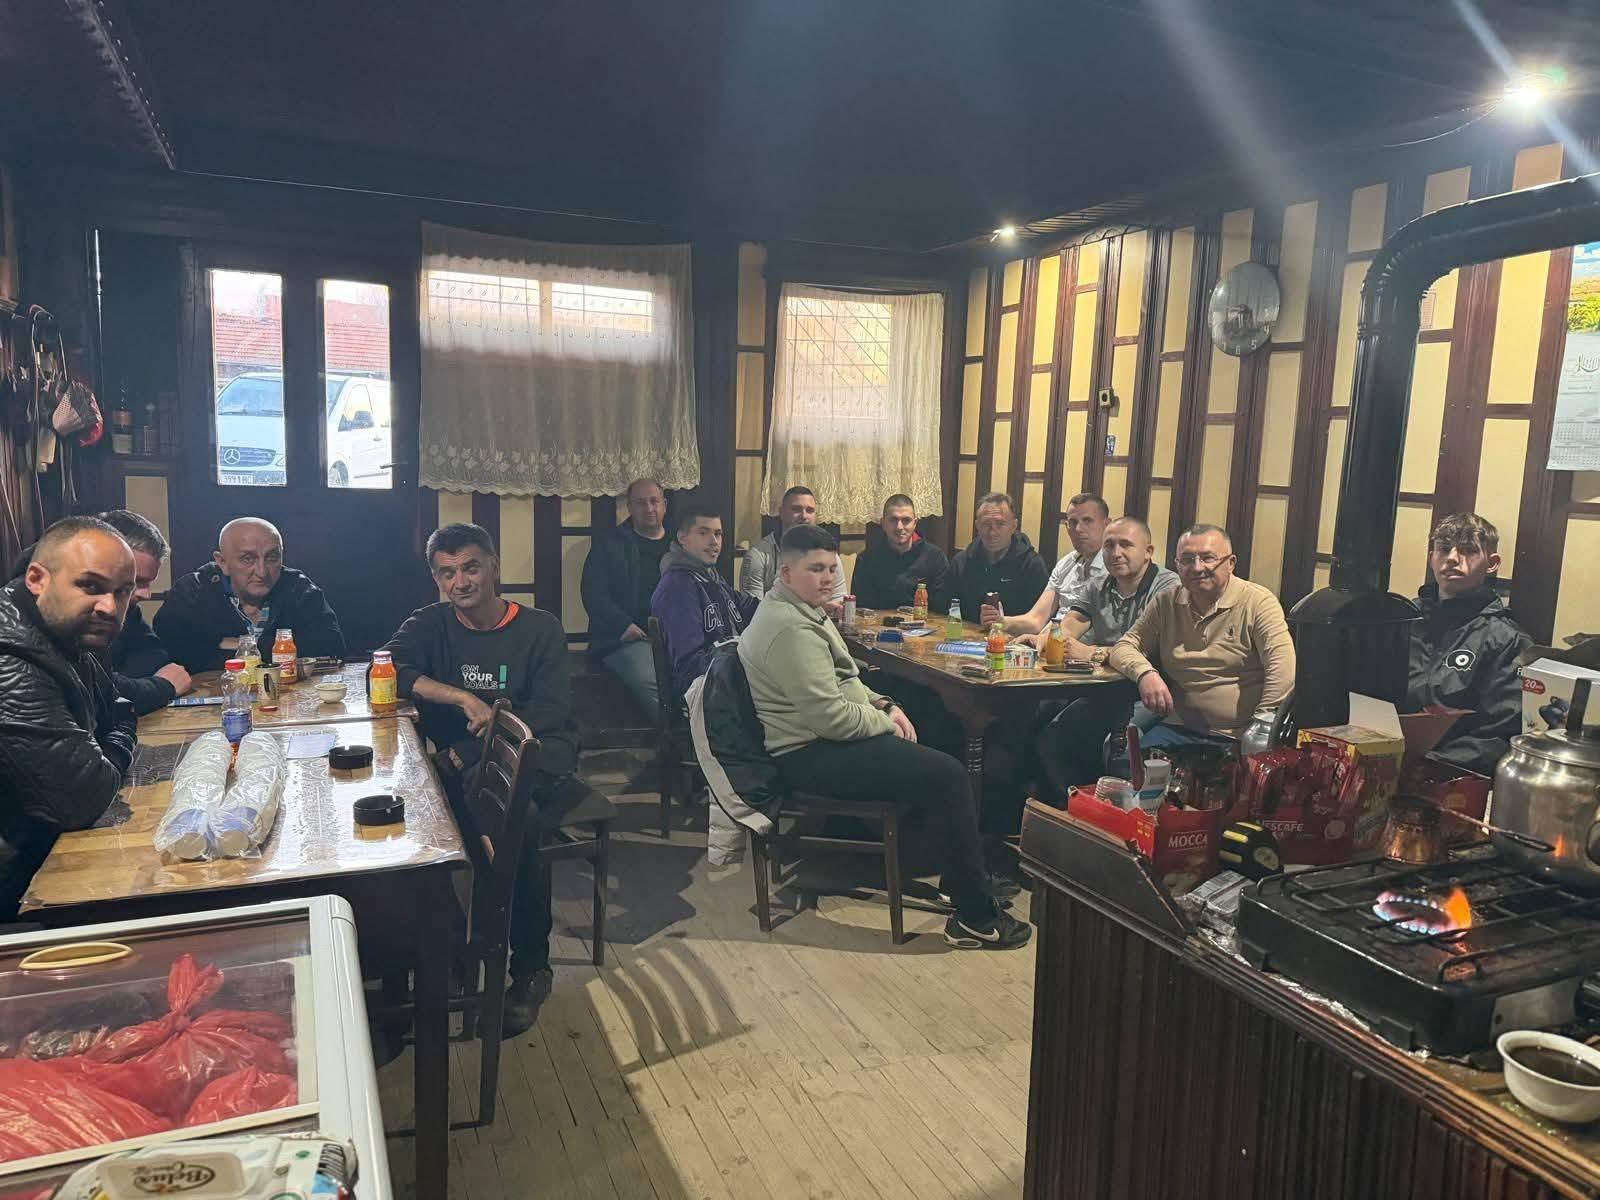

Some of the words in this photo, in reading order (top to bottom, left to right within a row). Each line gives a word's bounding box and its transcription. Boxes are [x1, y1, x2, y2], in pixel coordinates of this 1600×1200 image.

[1251, 339, 1257, 350] 5
[461, 664, 479, 673] ON
[462, 672, 493, 682] YOUR
[1524, 678, 1537, 689] 20
[1167, 833, 1208, 848] MOCCA
